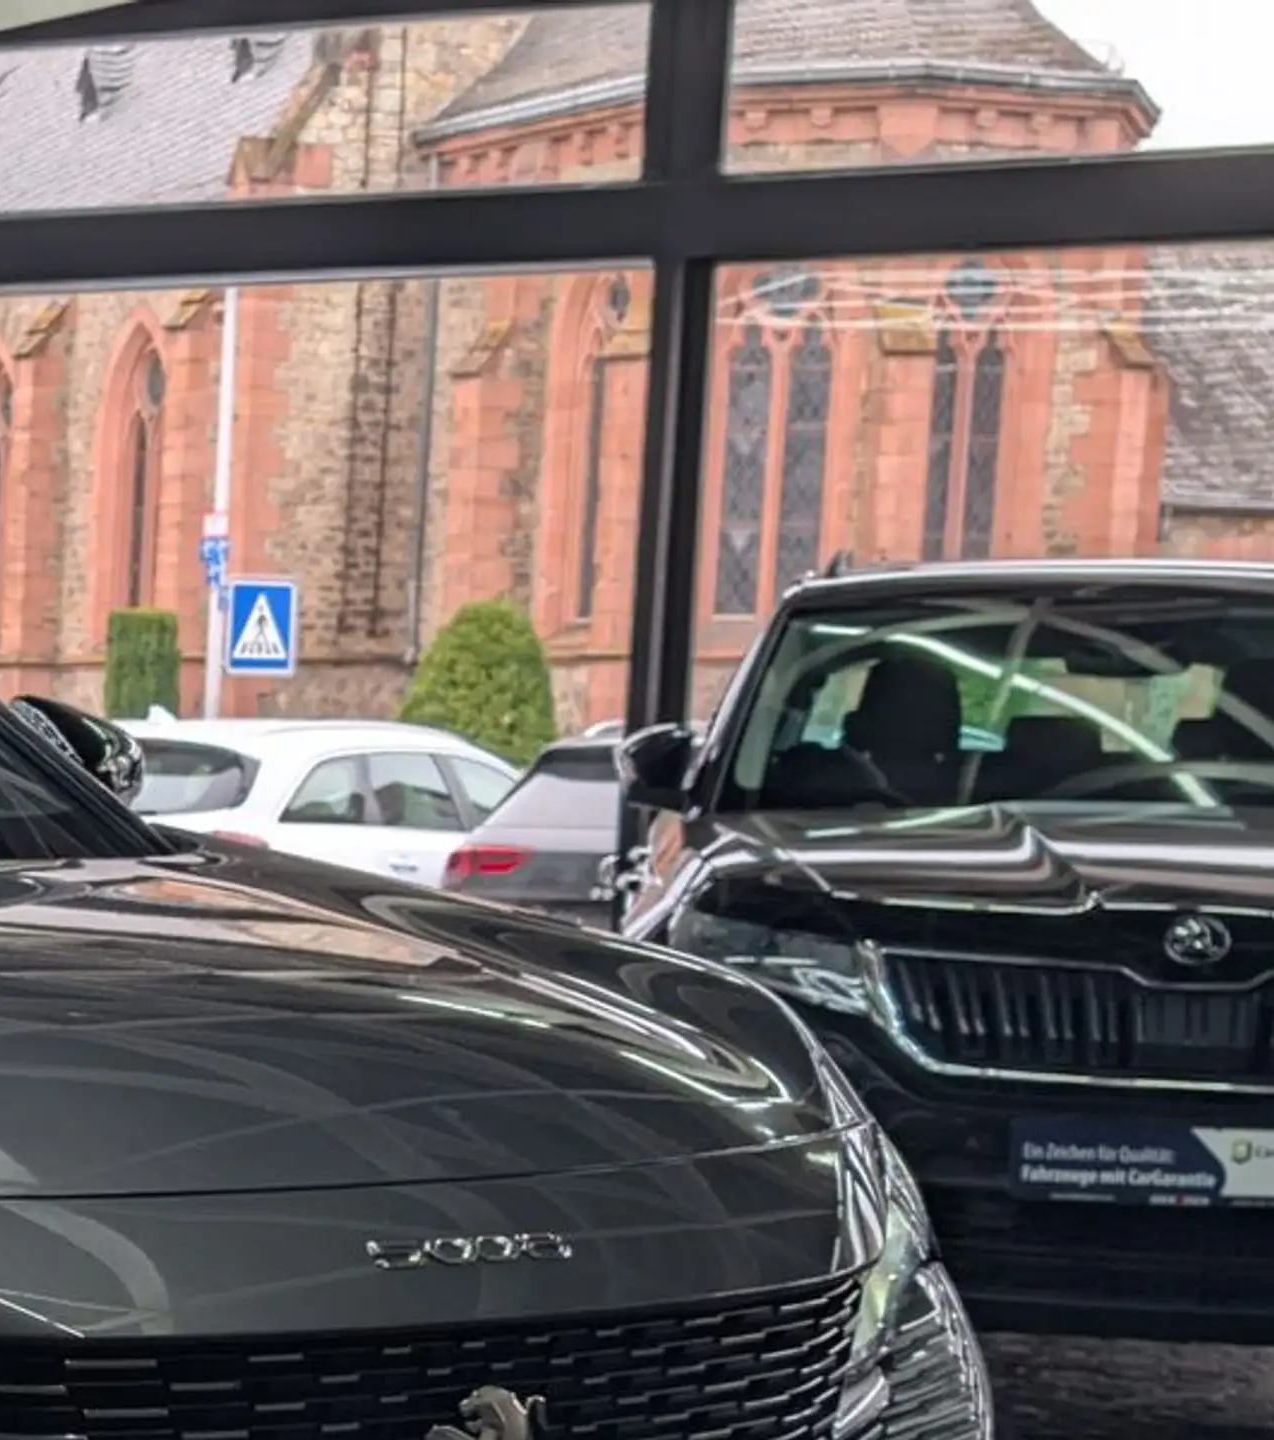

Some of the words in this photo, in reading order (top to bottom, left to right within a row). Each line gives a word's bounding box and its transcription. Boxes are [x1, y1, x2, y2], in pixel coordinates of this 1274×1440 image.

[1020, 1164, 1098, 1188] Fahrzeuge
[1099, 1167, 1126, 1186] mit
[365, 1230, 574, 1270] 5008
